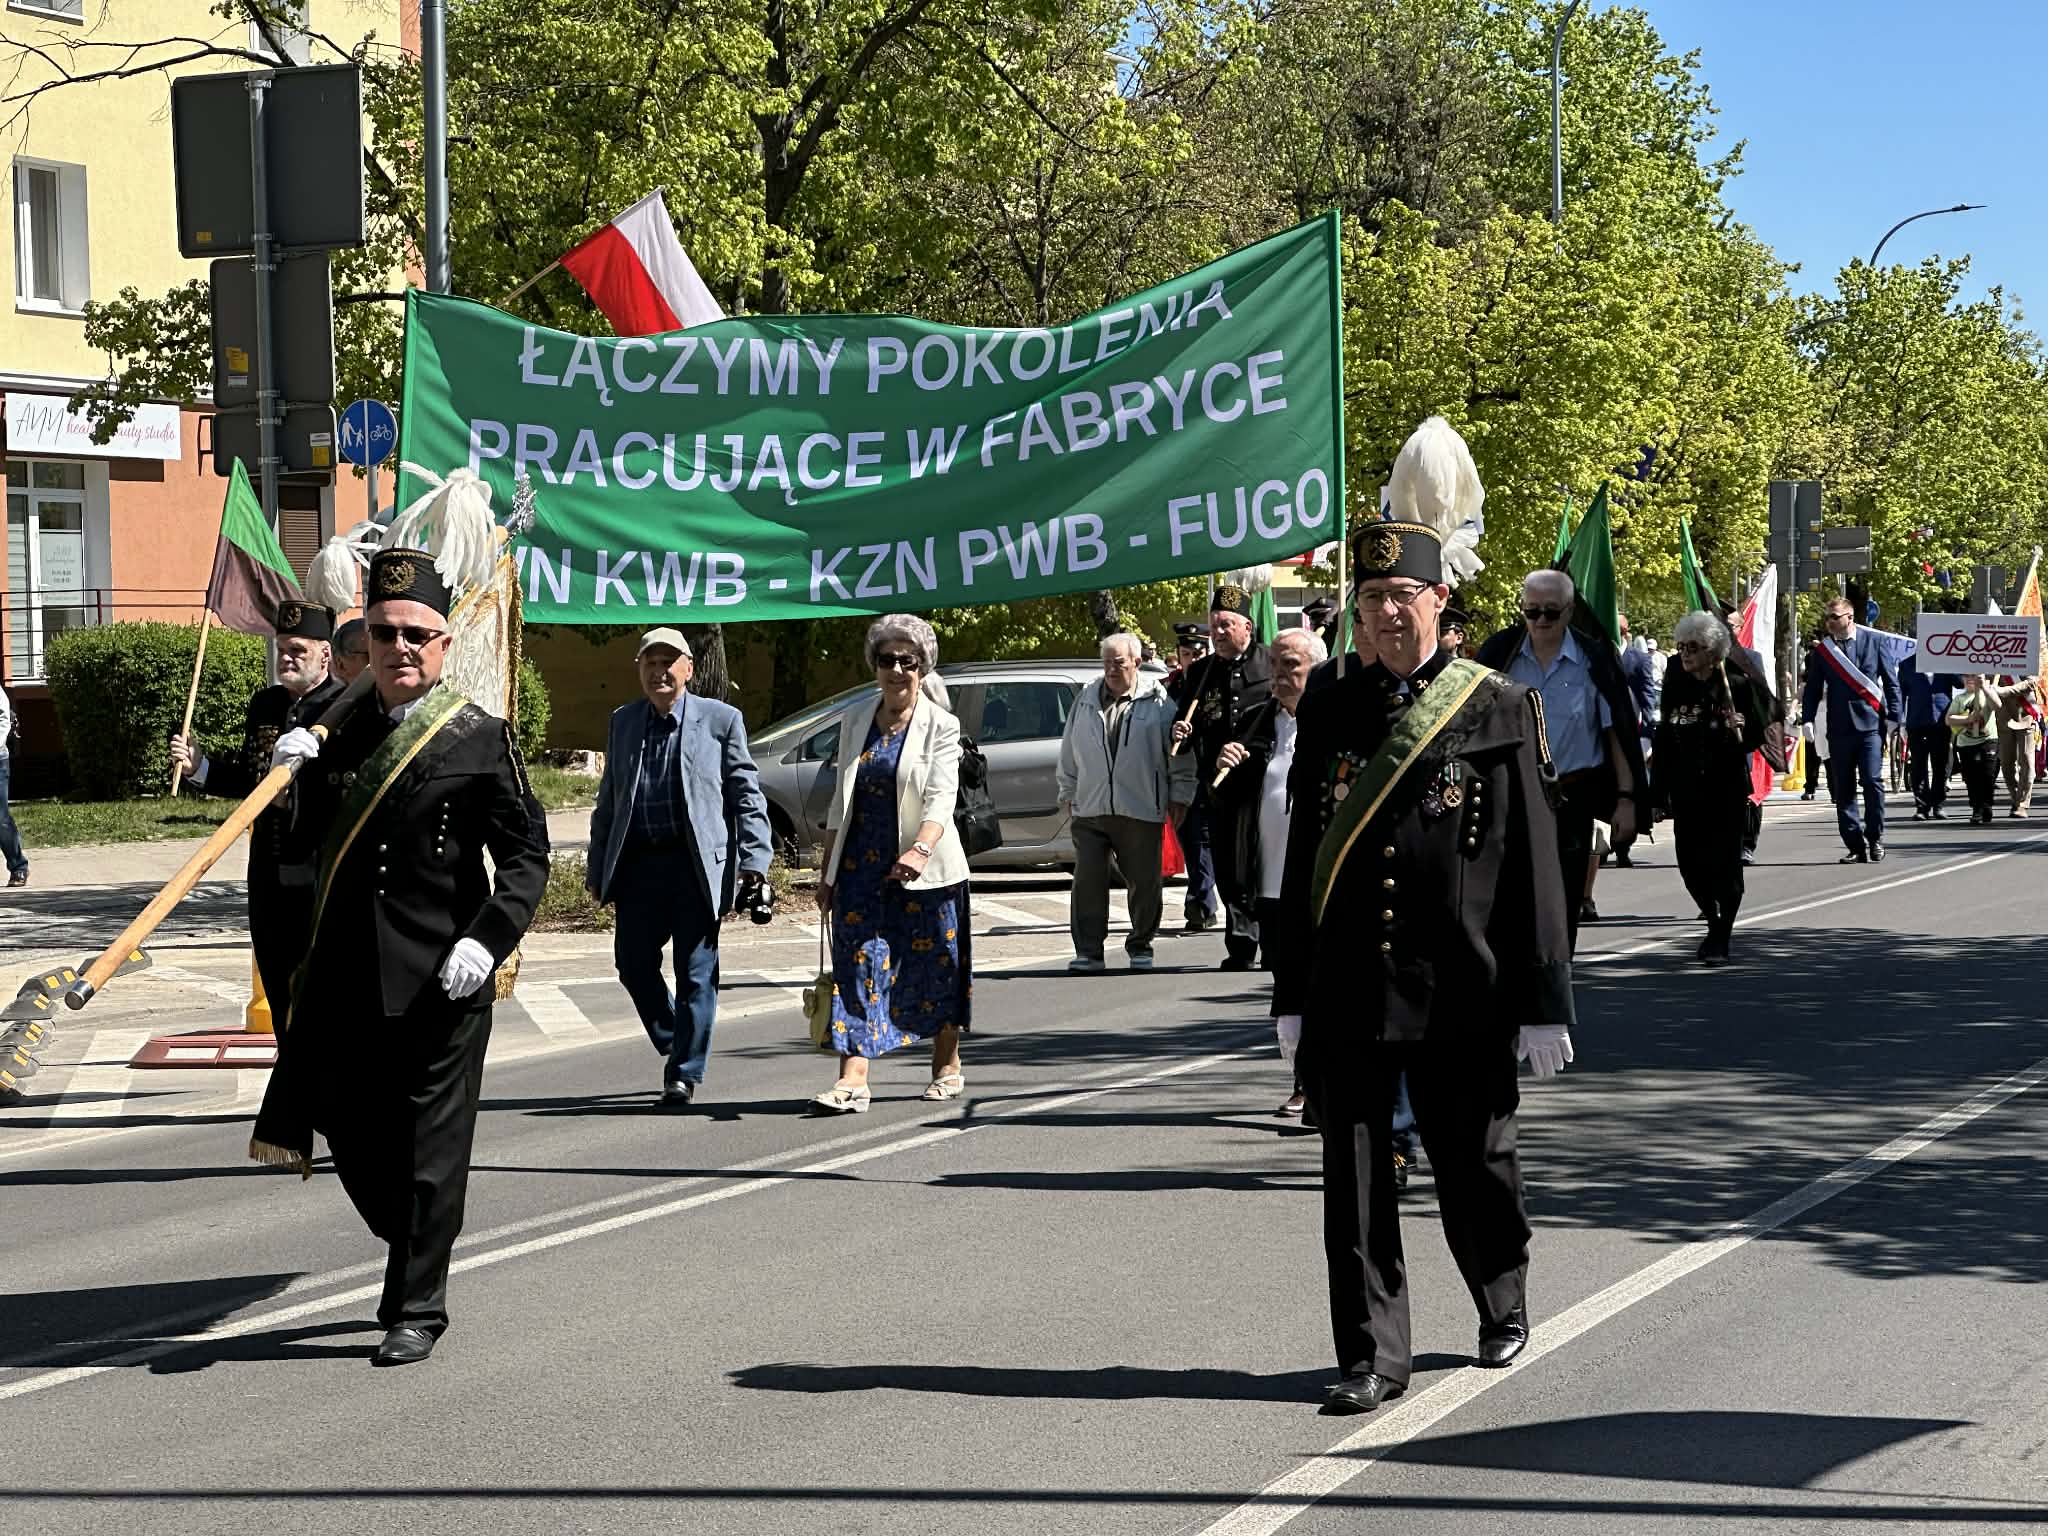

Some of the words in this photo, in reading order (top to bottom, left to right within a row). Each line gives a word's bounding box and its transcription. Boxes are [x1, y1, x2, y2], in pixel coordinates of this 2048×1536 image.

[518, 326, 845, 406] ŁĄCZYMY
[867, 280, 1233, 393] POKOLENIA
[469, 418, 885, 506] PRACUJĄCE
[907, 425, 967, 479] W
[980, 350, 1287, 467] FABRYCE
[594, 550, 748, 607] KWB
[768, 578, 788, 590] -
[809, 536, 938, 602] KZN
[958, 513, 1108, 586] PWB
[1129, 533, 1148, 547] -
[1167, 467, 1329, 557] FUGO
